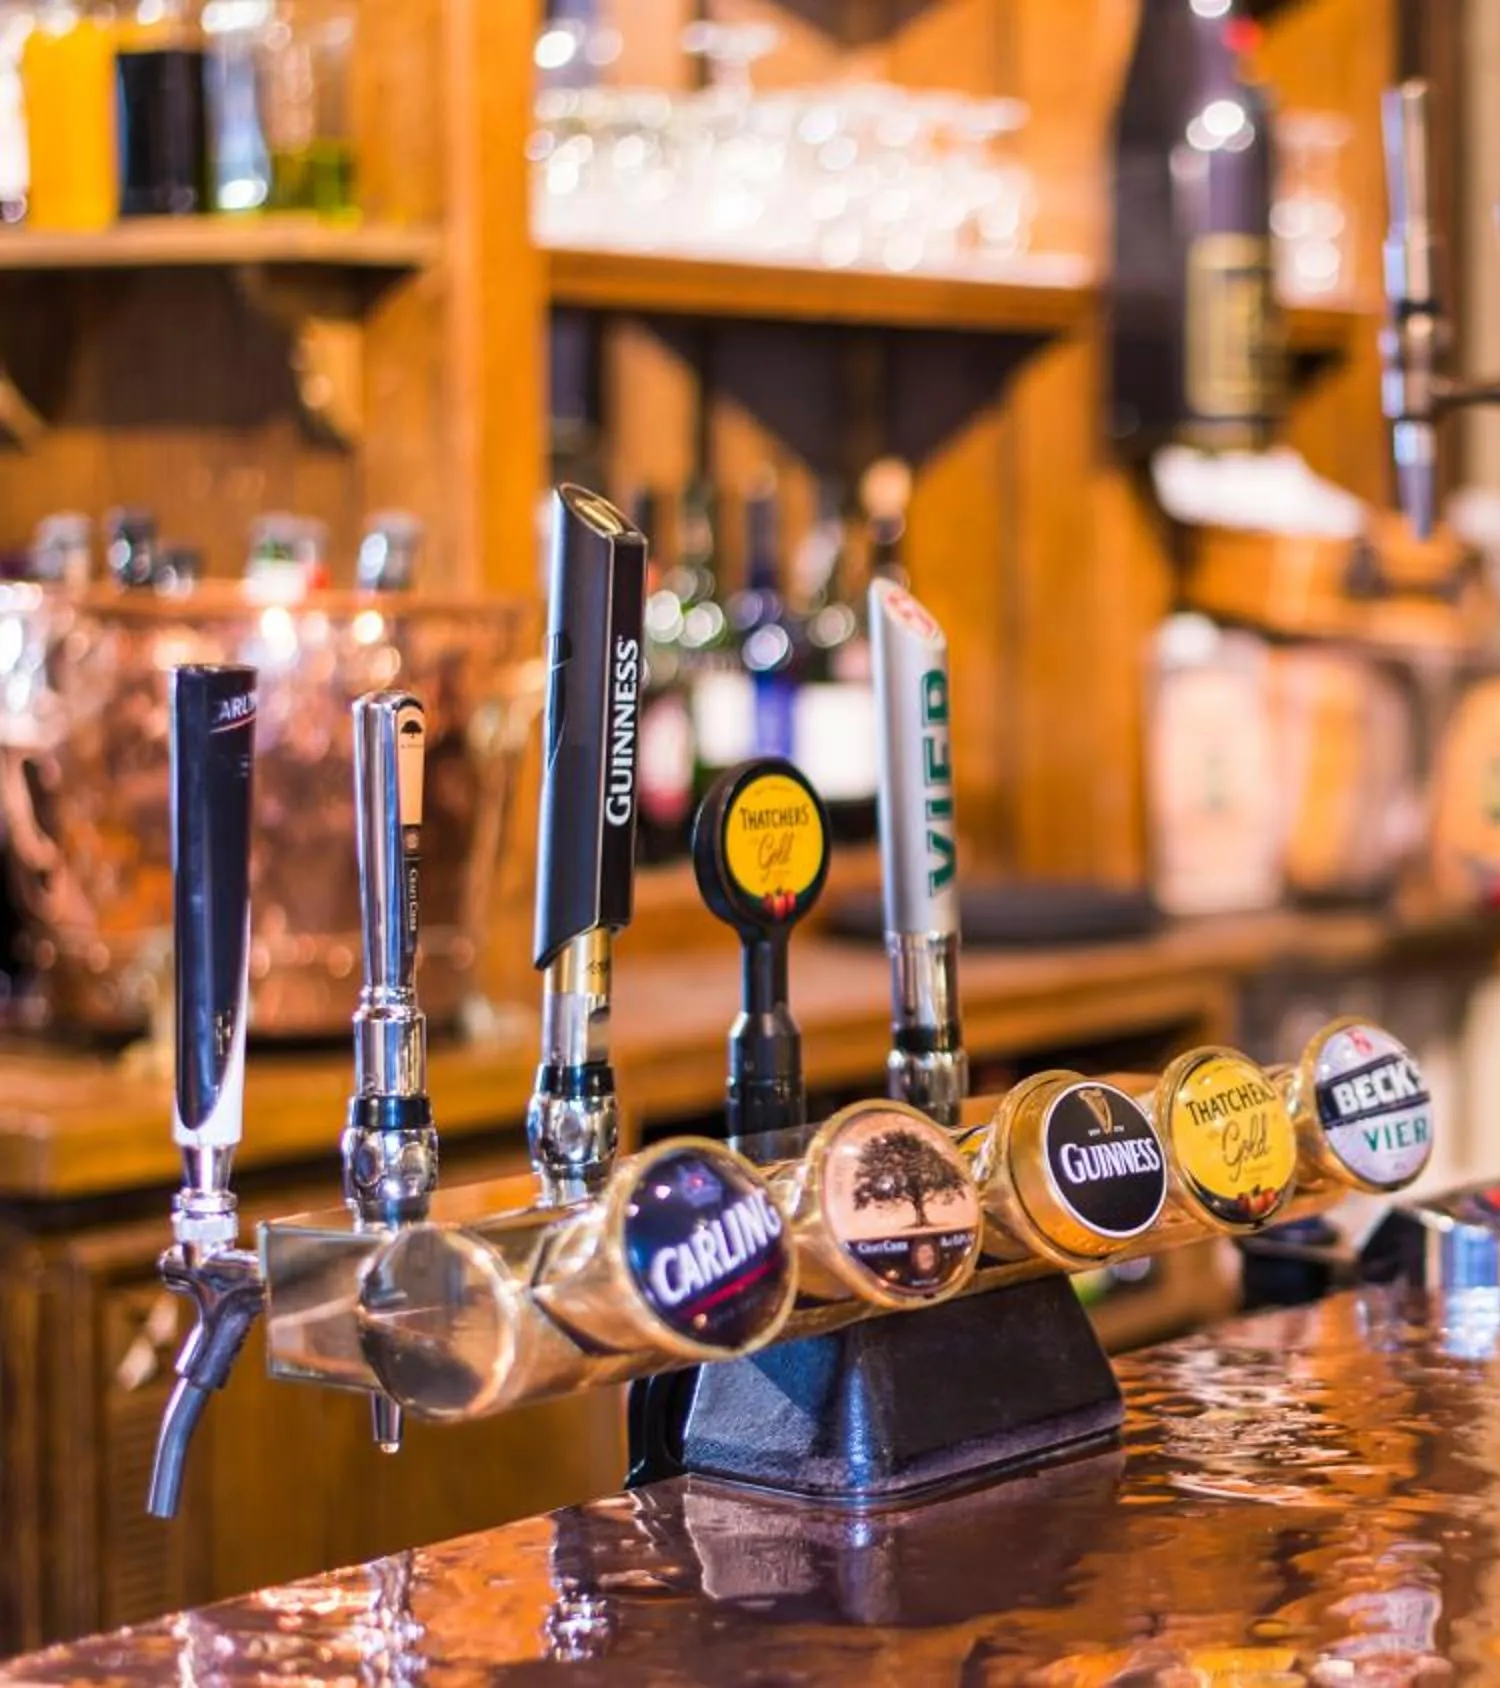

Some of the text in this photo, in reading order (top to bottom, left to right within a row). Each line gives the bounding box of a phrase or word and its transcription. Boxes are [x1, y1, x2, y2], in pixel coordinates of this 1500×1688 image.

[605, 639, 639, 826] GUINNESS
[740, 803, 810, 831] THATCHERS
[1060, 1137, 1161, 1184] GUINNESS
[1221, 1110, 1272, 1183] Gold
[1363, 1116, 1428, 1152] VIER
[651, 1187, 782, 1306] CARLING
